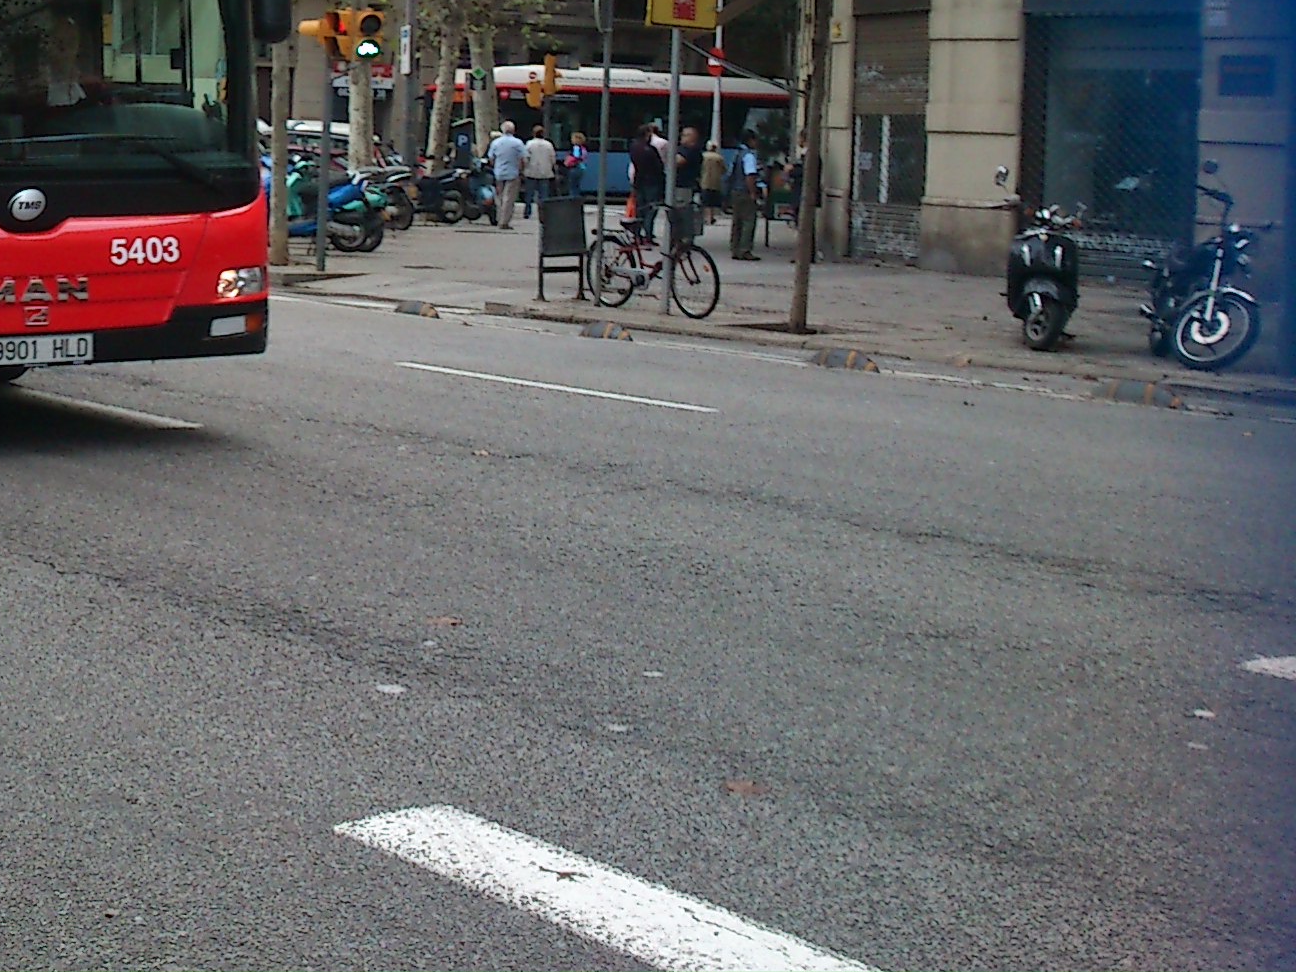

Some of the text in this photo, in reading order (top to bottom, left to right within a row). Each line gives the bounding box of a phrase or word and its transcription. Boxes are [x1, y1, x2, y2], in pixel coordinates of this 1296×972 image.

[457, 134, 468, 147] P
[110, 236, 180, 265] 5403
[52, 337, 89, 359] HLD
